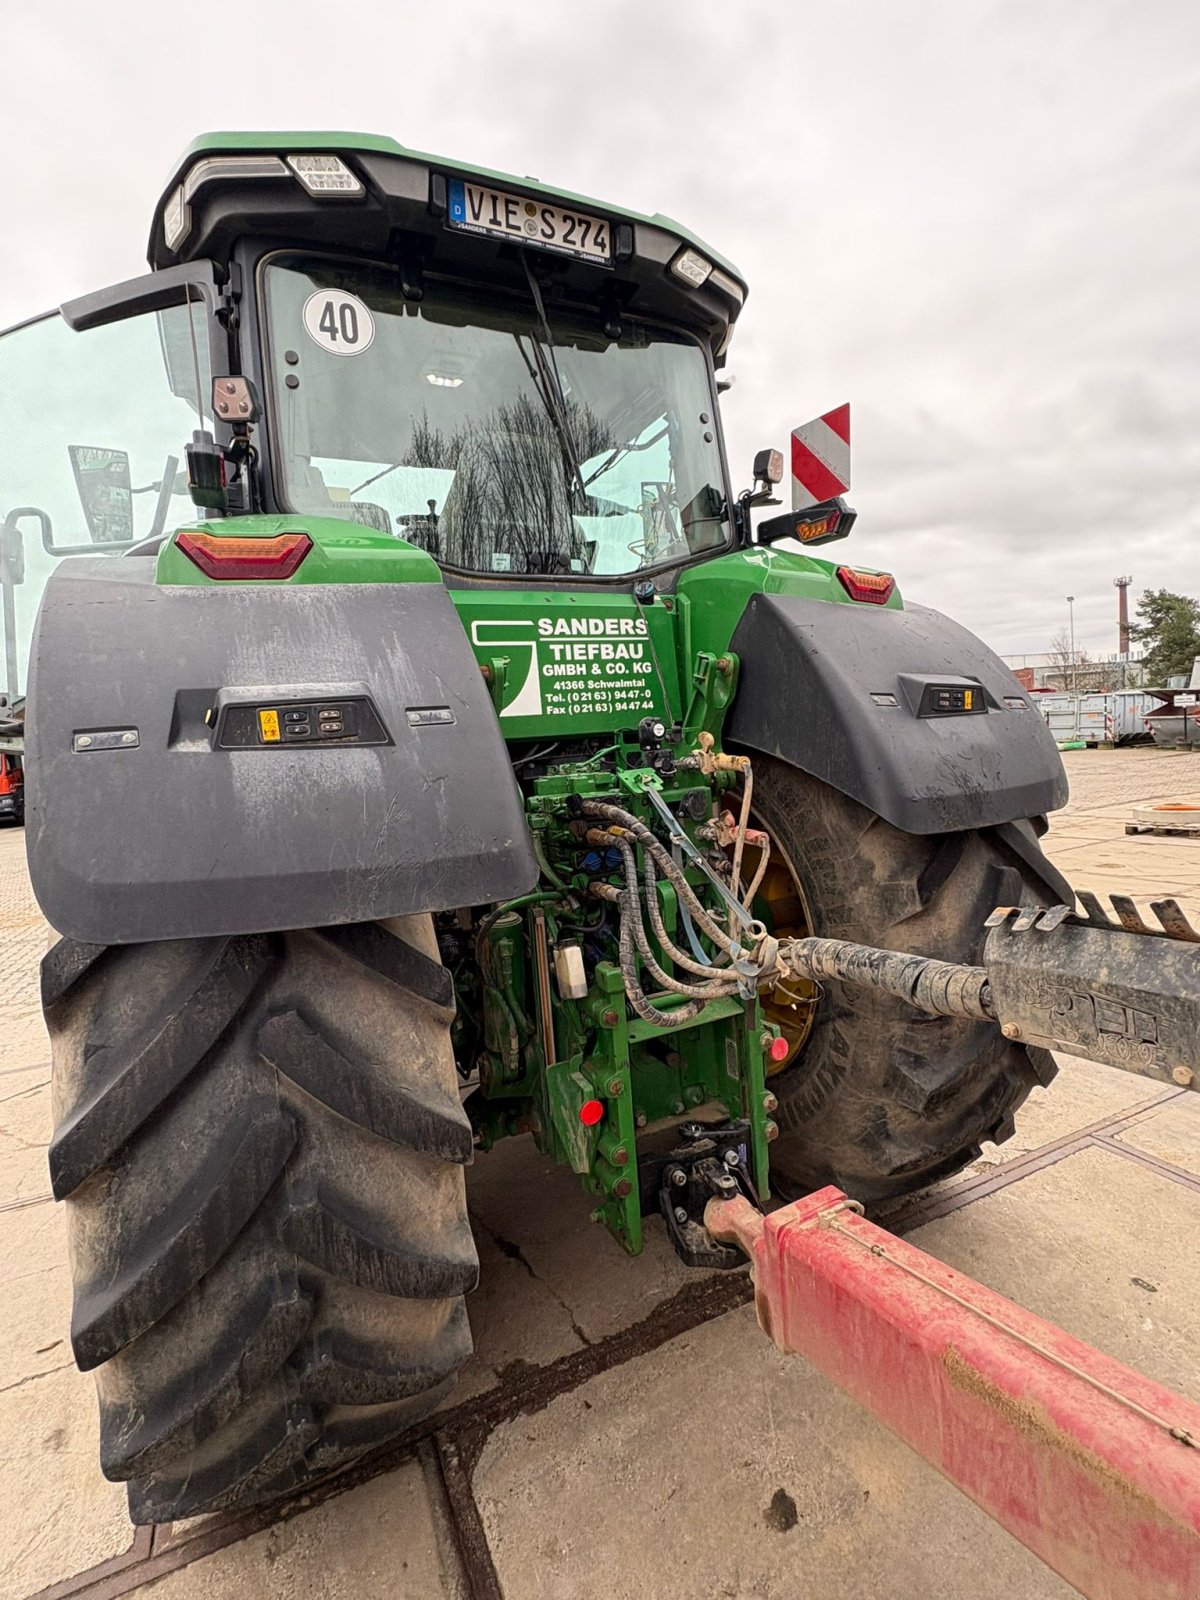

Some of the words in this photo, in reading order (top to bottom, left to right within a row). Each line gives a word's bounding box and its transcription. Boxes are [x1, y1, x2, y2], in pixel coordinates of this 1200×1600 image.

[454, 204, 462, 216] D
[467, 188, 521, 232] VIE
[319, 301, 359, 344] 40
[537, 618, 649, 635] SANDERS
[549, 643, 644, 660] TIEFBAU
[543, 664, 587, 677] GMBH
[591, 663, 602, 675] &
[605, 662, 630, 675] CO.
[633, 662, 652, 674] KG
[553, 680, 585, 690] 41366
[587, 678, 645, 689] Schwalmtal
[545, 693, 566, 703] Tel.
[546, 705, 566, 715] Fax
